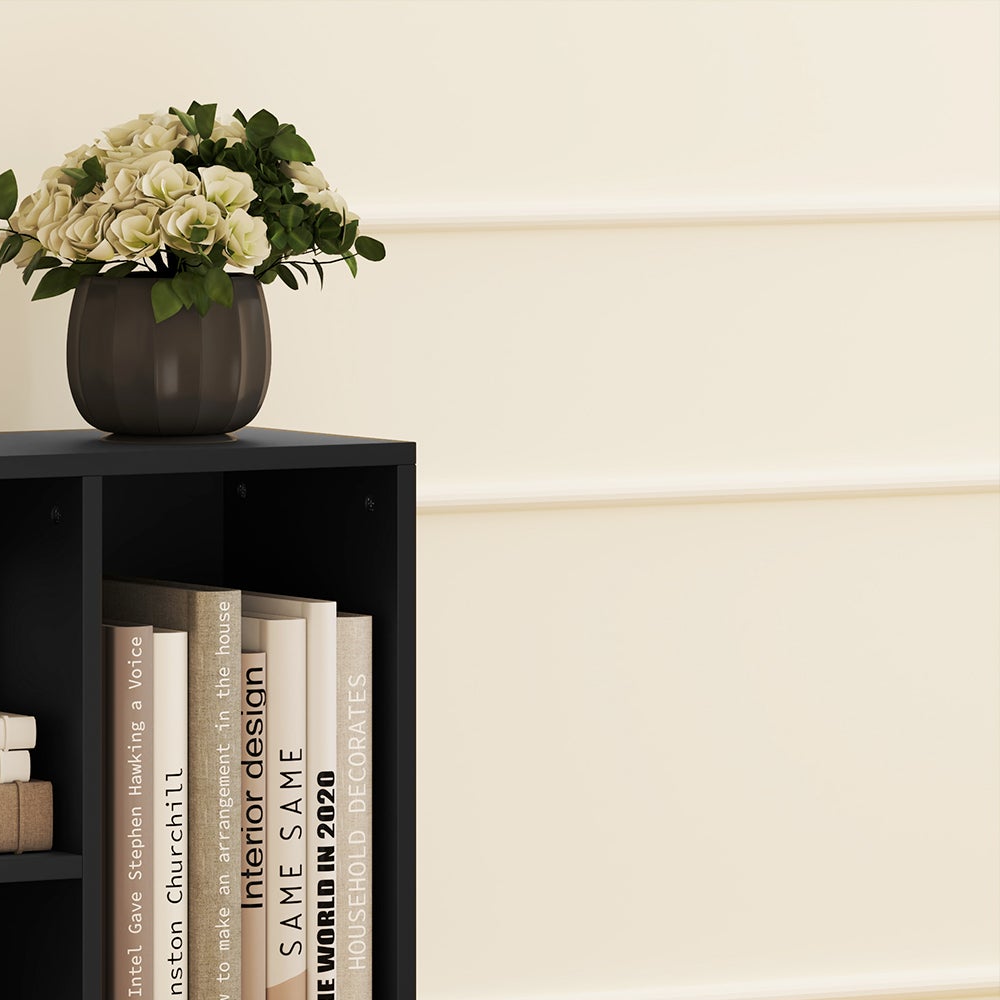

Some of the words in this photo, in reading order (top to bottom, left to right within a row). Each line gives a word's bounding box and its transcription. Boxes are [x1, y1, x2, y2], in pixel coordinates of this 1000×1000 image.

[128, 636, 142, 689] Voice
[215, 601, 230, 655] house
[132, 701, 142, 710] a
[215, 667, 230, 698] the
[215, 710, 230, 731] in
[241, 667, 266, 779] design
[348, 674, 366, 813] DECORATES
[128, 721, 145, 795] Hawking
[216, 743, 233, 862] arrangement
[279, 749, 302, 839] SAME
[317, 770, 335, 839] 2020
[128, 807, 145, 880] Stephen
[166, 768, 183, 903] Churchill
[241, 790, 263, 908] Interior
[317, 846, 335, 872] IN
[129, 892, 142, 933] Gave
[219, 875, 230, 895] an
[279, 864, 302, 956] SAME
[348, 830, 366, 970] HOUSEHOLD
[215, 907, 230, 950] make
[317, 879, 335, 973] WORLD
[128, 945, 142, 996] Intel
[216, 963, 230, 981] to
